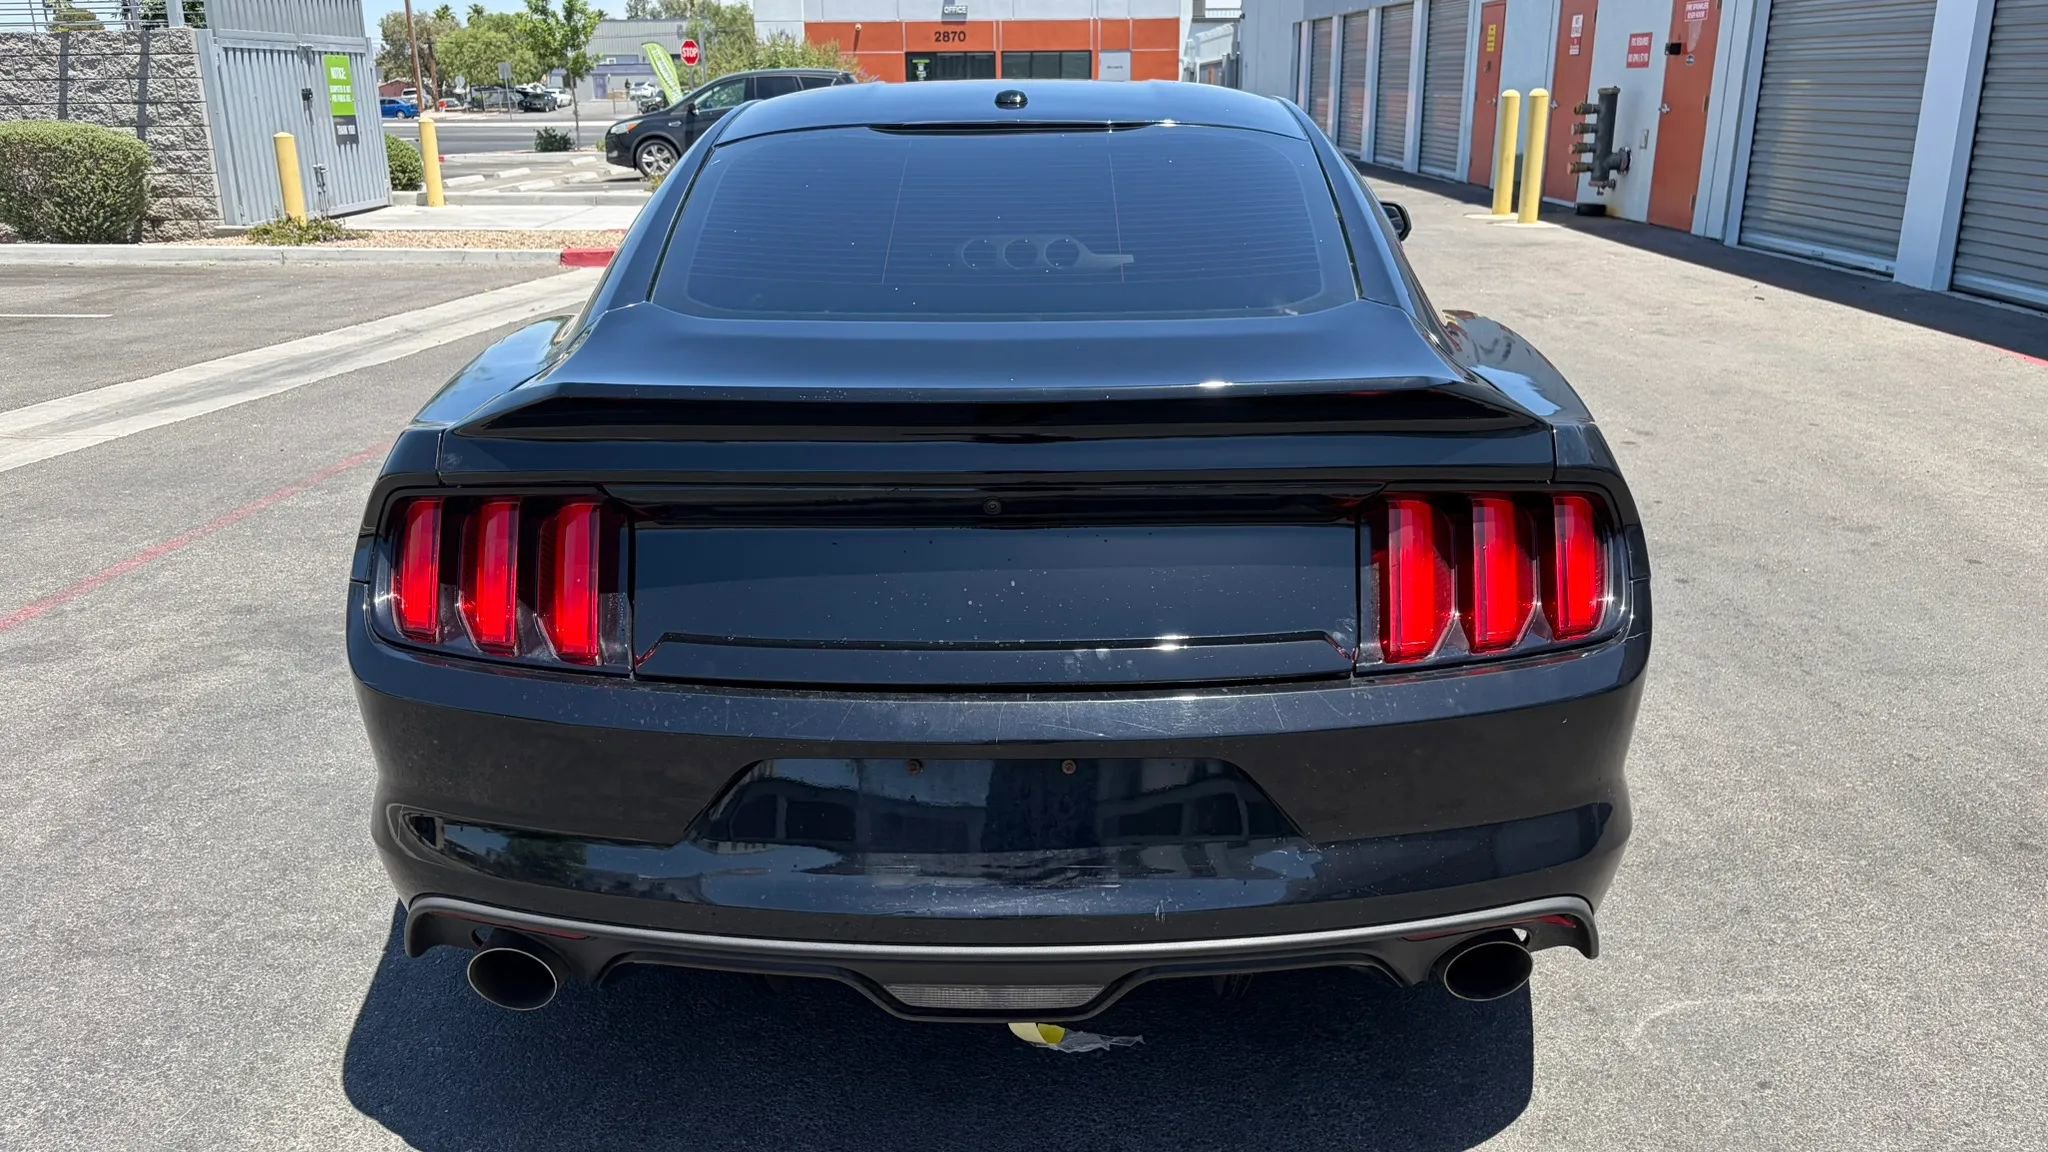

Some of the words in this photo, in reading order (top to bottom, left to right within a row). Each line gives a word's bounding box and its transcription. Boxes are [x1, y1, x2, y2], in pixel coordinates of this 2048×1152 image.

[943, 6, 967, 14] OFFICE
[934, 31, 966, 42] 2870
[682, 47, 698, 57] STOP
